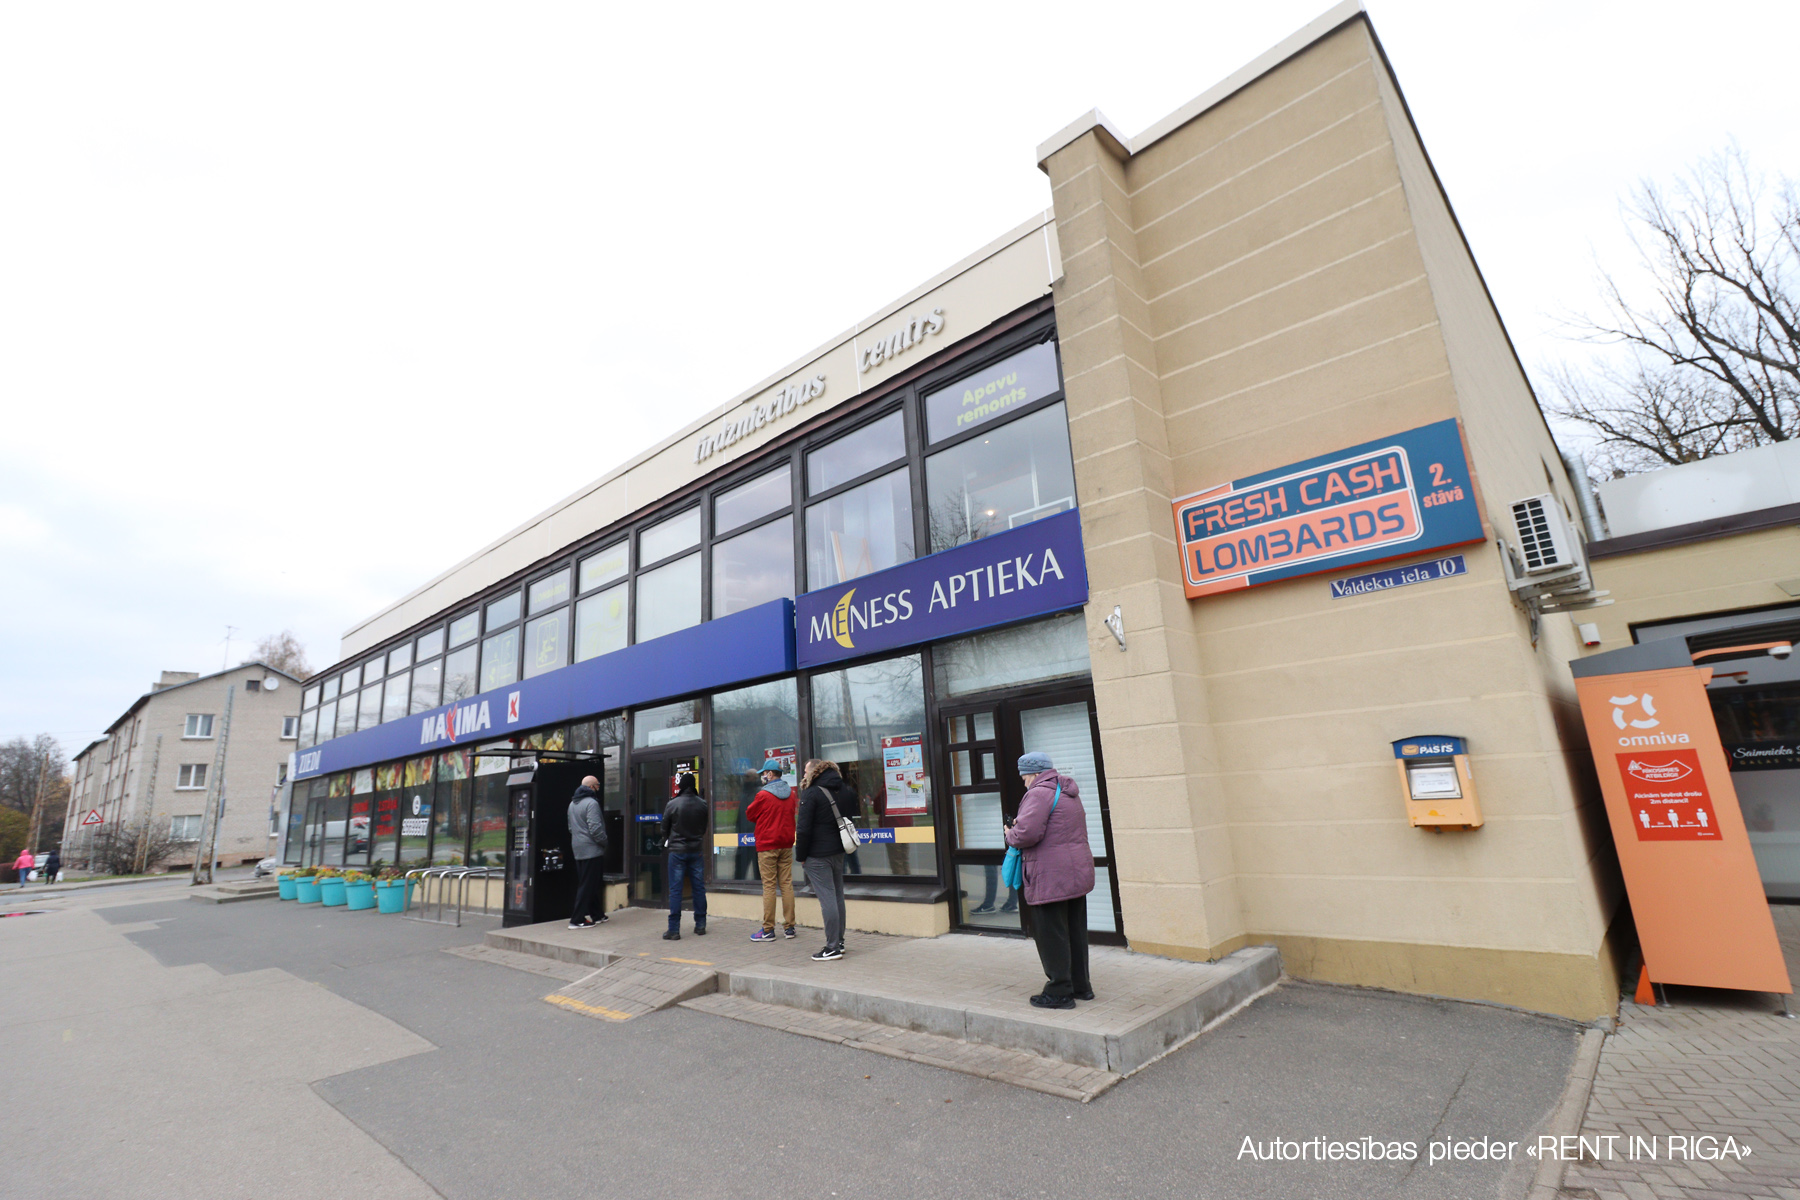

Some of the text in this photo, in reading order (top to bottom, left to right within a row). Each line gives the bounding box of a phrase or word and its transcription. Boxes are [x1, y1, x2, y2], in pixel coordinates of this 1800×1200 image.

[858, 306, 945, 374] centrs
[956, 386, 1027, 427] remonts
[961, 371, 1018, 407] Apavu
[1428, 462, 1453, 488] 2.
[1187, 456, 1401, 536] FRESH CASH
[1422, 485, 1465, 509] stāvā
[1195, 502, 1406, 575] LOMBARDS
[809, 547, 1065, 645] MĒNESS APTIEKA
[1331, 558, 1457, 596] Valdeku iela 10
[420, 700, 492, 743] MAXIMA
[1618, 731, 1690, 747] omniva
[1420, 744, 1454, 754] PASTS
